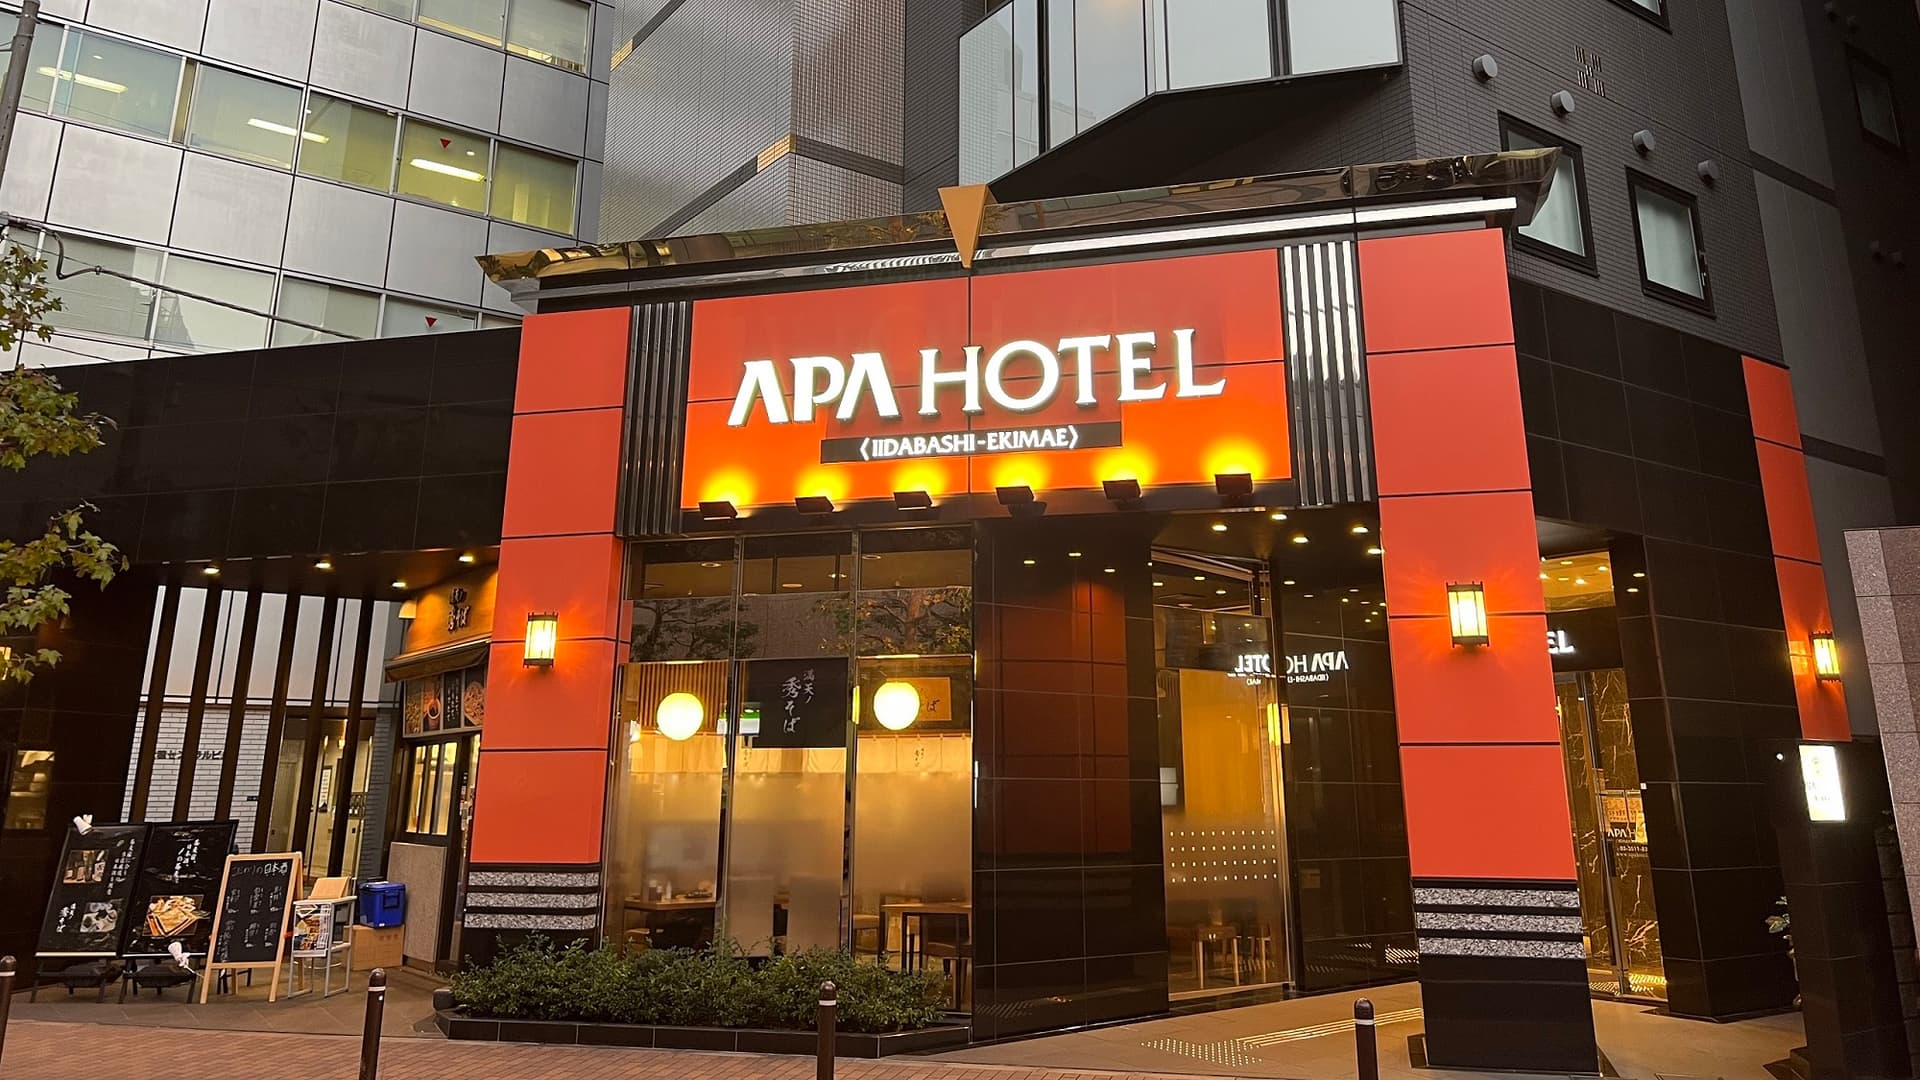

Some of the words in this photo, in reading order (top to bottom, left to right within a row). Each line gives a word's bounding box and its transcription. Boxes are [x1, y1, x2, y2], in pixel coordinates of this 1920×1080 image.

[728, 352, 902, 427] APA
[917, 328, 1227, 417] HOTEL
[780, 676, 802, 734] 秀そば
